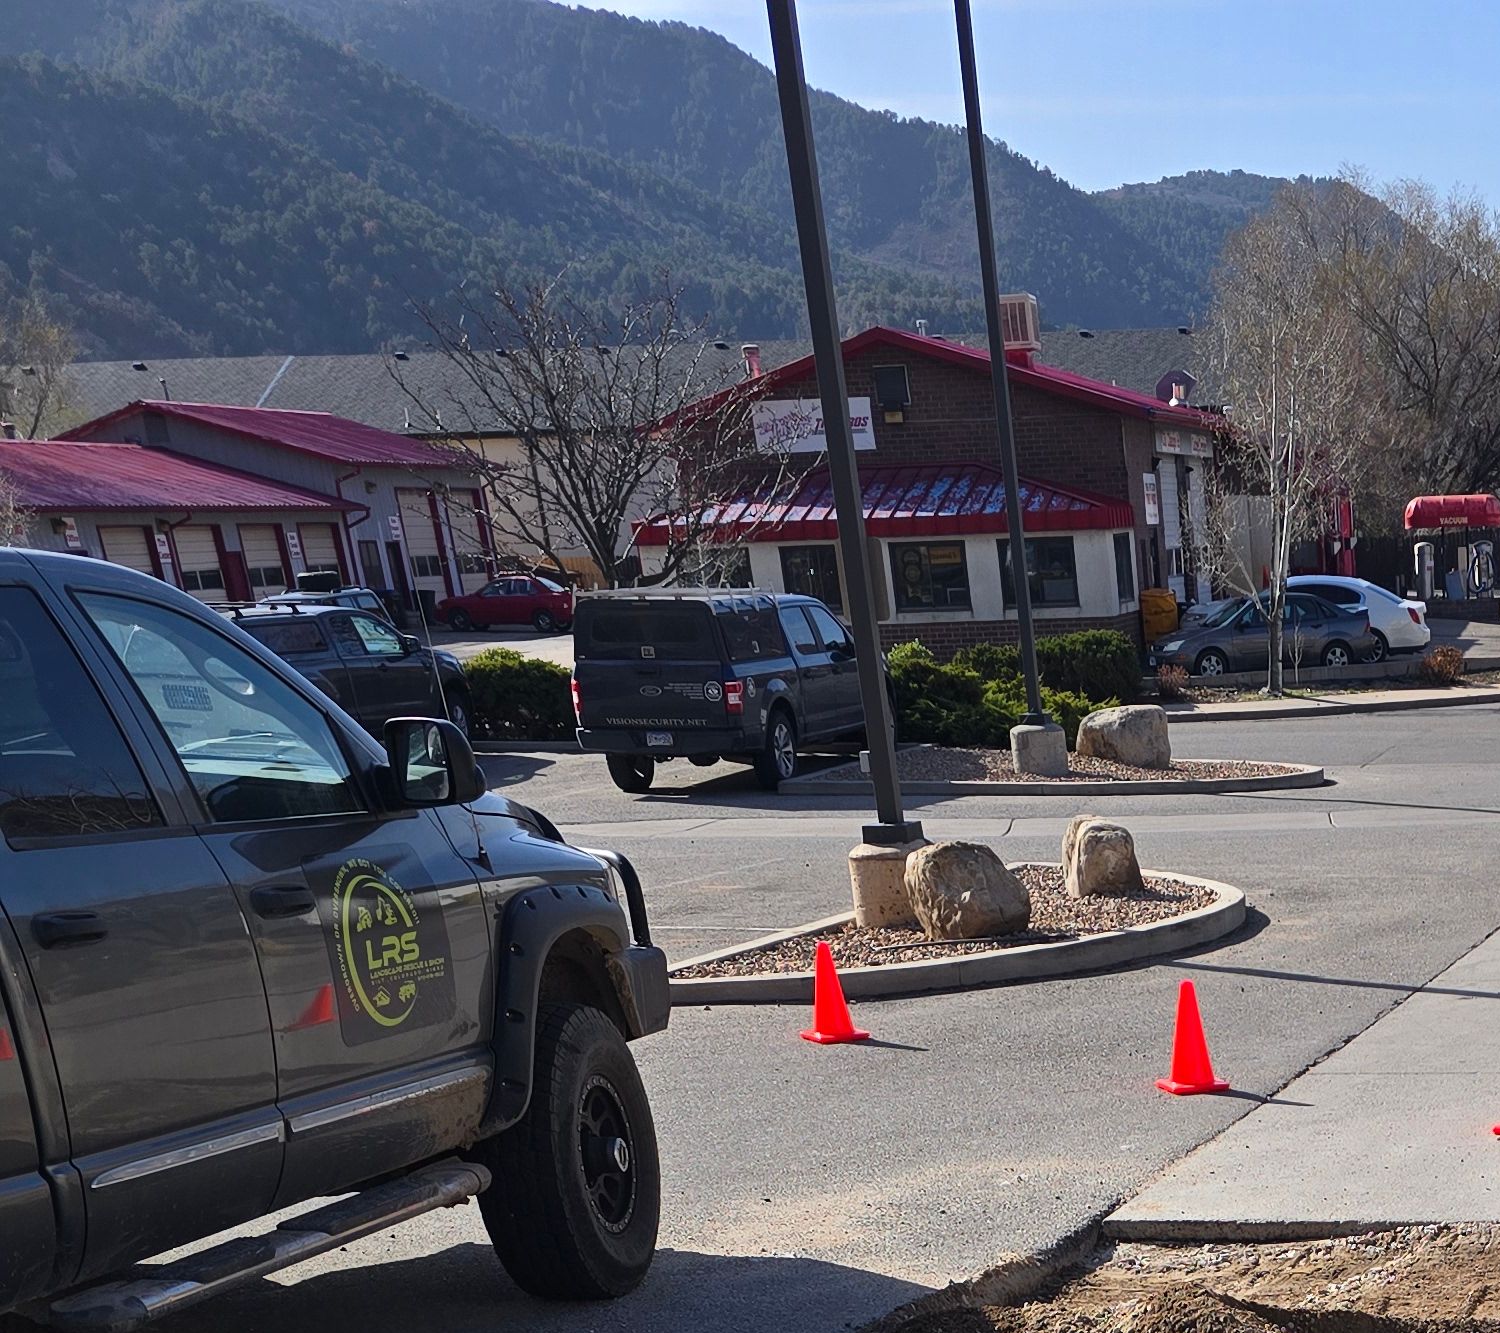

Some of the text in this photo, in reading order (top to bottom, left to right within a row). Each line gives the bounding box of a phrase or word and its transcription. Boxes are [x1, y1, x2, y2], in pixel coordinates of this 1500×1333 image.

[1439, 517, 1468, 525] VACUUM
[606, 718, 708, 726] VISIONSECURITY.NET
[334, 923, 340, 939] OR
[366, 931, 419, 970] LRS
